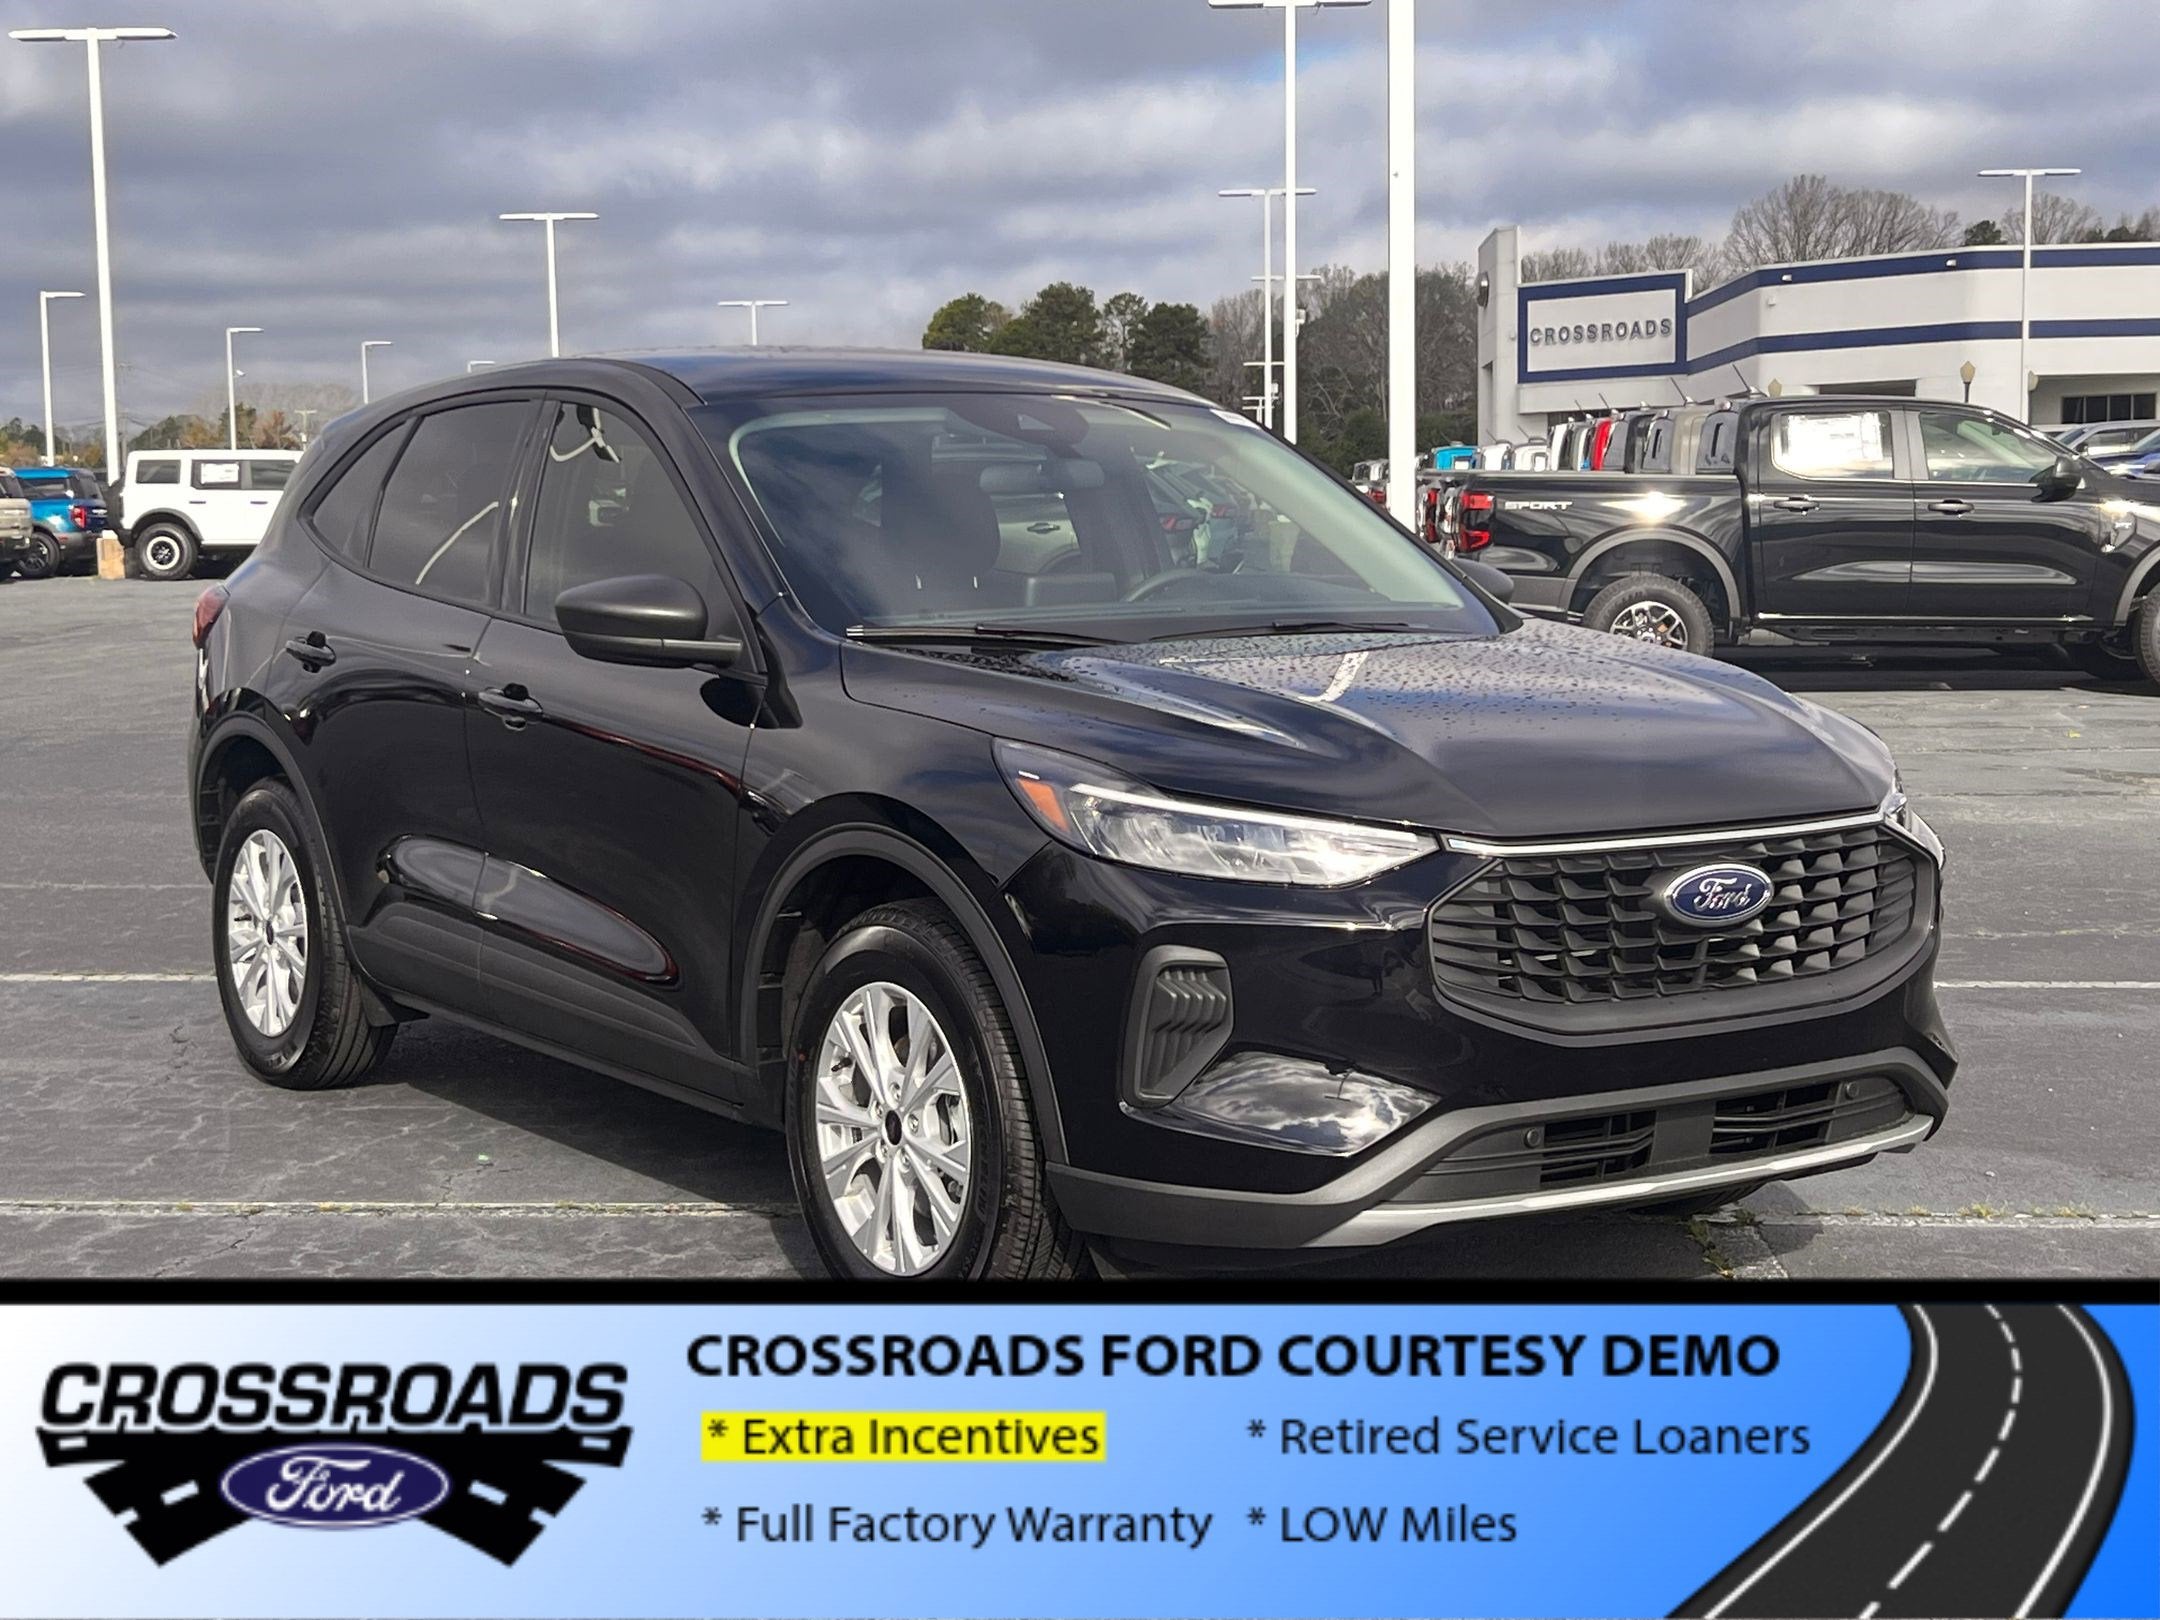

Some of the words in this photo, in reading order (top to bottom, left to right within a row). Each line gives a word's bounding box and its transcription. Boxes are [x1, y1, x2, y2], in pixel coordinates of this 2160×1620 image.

[1530, 318, 1673, 346] CROSSROADS
[1505, 501, 1573, 510] SPORT
[1693, 877, 1752, 912] Ford
